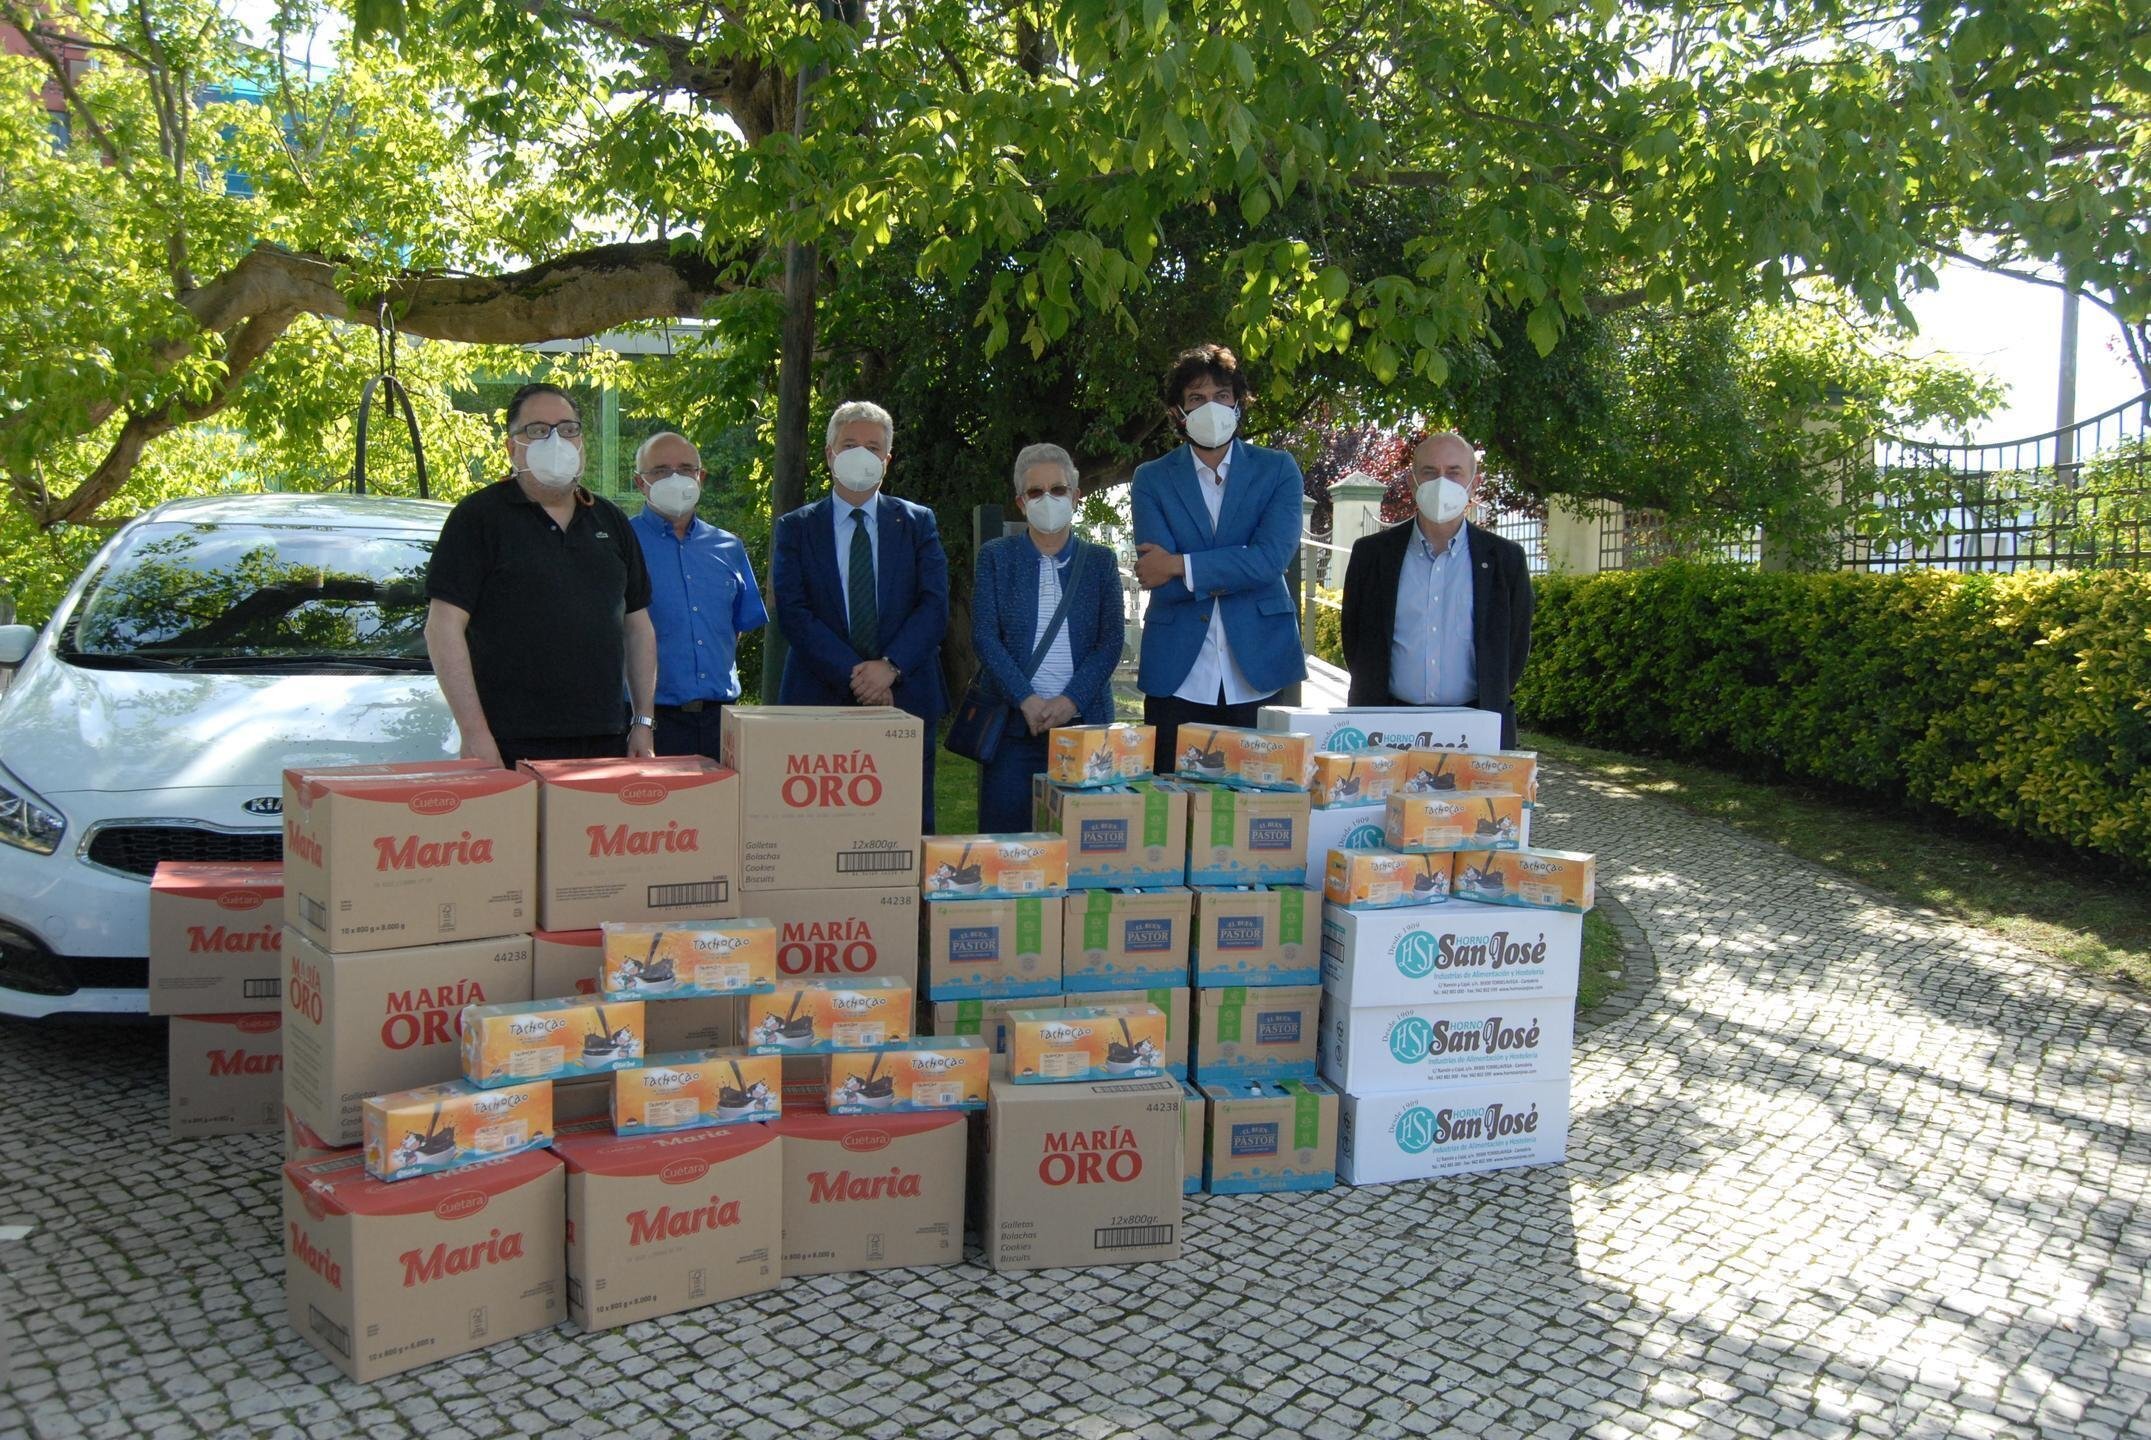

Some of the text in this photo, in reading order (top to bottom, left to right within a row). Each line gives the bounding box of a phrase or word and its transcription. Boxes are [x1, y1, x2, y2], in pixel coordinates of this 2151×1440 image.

[885, 729, 917, 738] 44238
[1384, 734, 1415, 743] HORNO
[786, 749, 877, 774] MARÍA
[781, 774, 883, 808] ORO
[287, 820, 323, 870] Maria
[586, 820, 699, 858] Maria
[1084, 831, 1124, 841] PASTOR
[1252, 831, 1290, 840] PASTOR
[373, 830, 495, 872] Maria
[880, 896, 912, 906] 44238
[782, 917, 873, 943] MARÍA
[1128, 932, 1169, 941] PASTOR
[1221, 929, 1260, 938] PASTOR
[1456, 936, 1489, 945] HORNO
[494, 951, 527, 962] 44238
[777, 941, 877, 975] ORO
[953, 941, 996, 951] PASTOR
[1434, 931, 1546, 969] San José
[290, 977, 322, 1025] ORO
[384, 978, 486, 1014] MARÍA
[380, 1009, 463, 1050] OR
[1261, 1025, 1298, 1033] PASTOR
[1429, 1017, 1540, 1056] San José
[1450, 1020, 1483, 1031] HORNO
[207, 1049, 283, 1076] Mar
[1146, 1103, 1179, 1112] 44238
[1453, 1107, 1485, 1119] HORNO
[341, 1117, 362, 1126] Cook
[1433, 1102, 1539, 1144] San José
[653, 1129, 732, 1148] Maria
[1044, 1125, 1137, 1152] MARÍA
[1234, 1136, 1275, 1146] PASTOR
[1039, 1150, 1142, 1186] ORO
[807, 1167, 921, 1204] Maria
[626, 1195, 742, 1247] Maria
[290, 1221, 342, 1292] Maria
[400, 1228, 525, 1288] Maria
